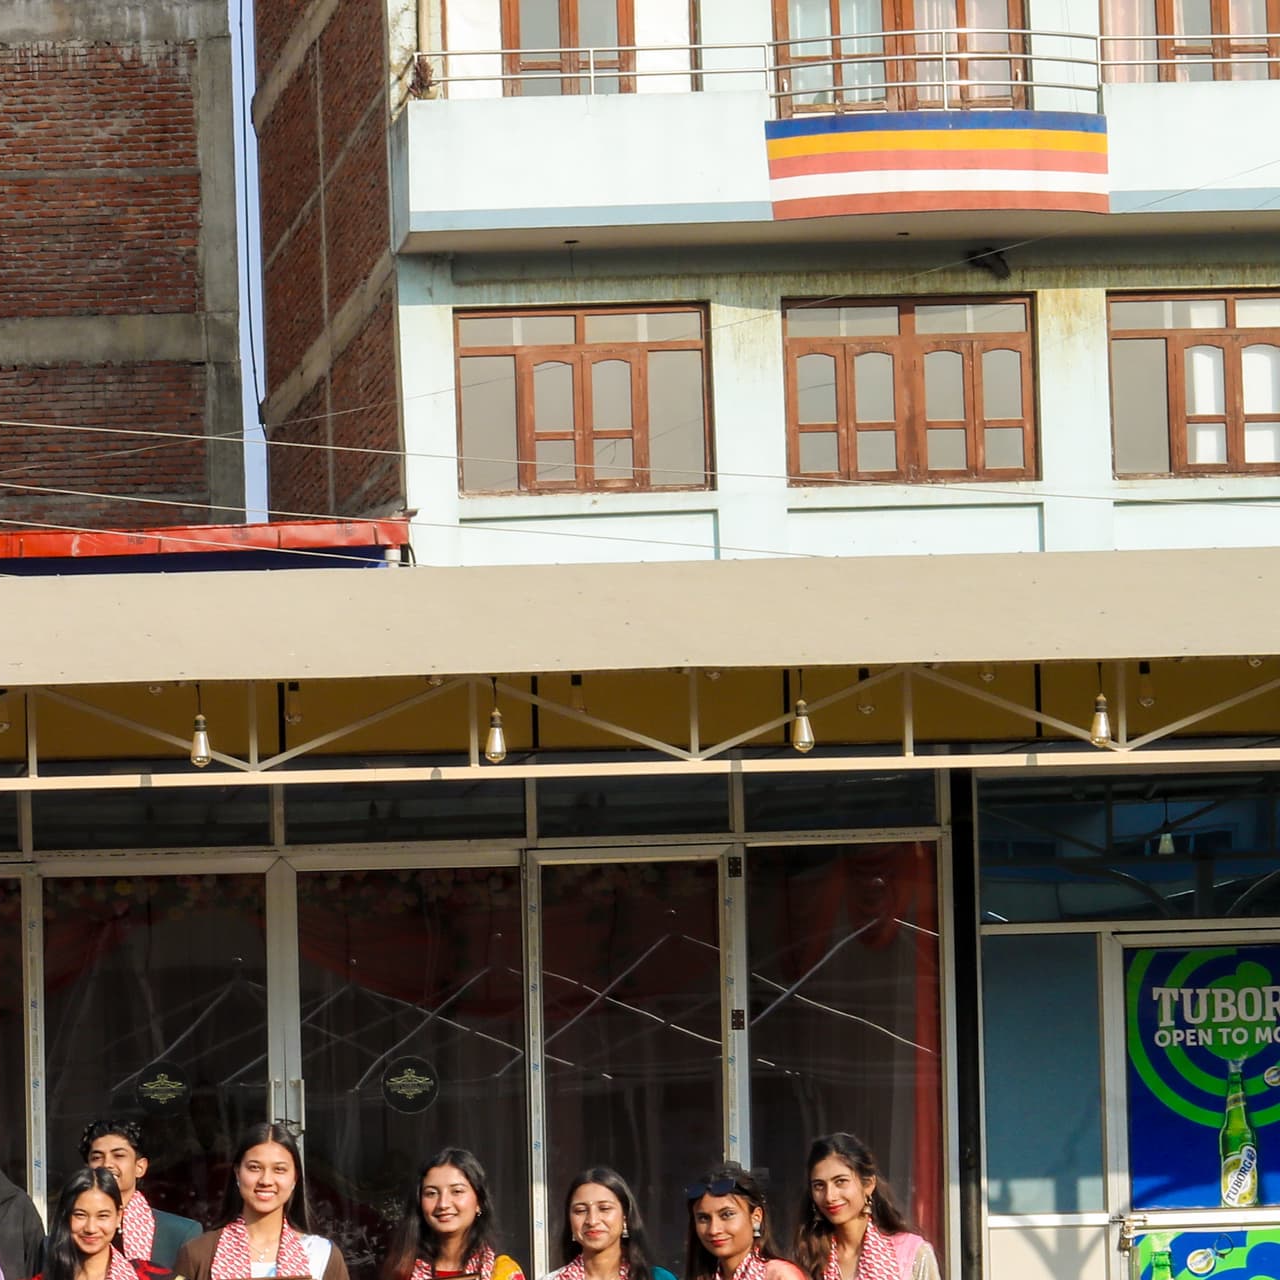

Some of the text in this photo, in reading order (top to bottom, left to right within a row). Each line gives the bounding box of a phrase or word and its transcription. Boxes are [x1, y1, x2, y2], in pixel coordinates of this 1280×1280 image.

[1152, 985, 1280, 1028] TUBOR
[1154, 1028, 1213, 1048] OPEN
[1217, 1027, 1249, 1045] TO
[1226, 1159, 1252, 1202] TUBORG
